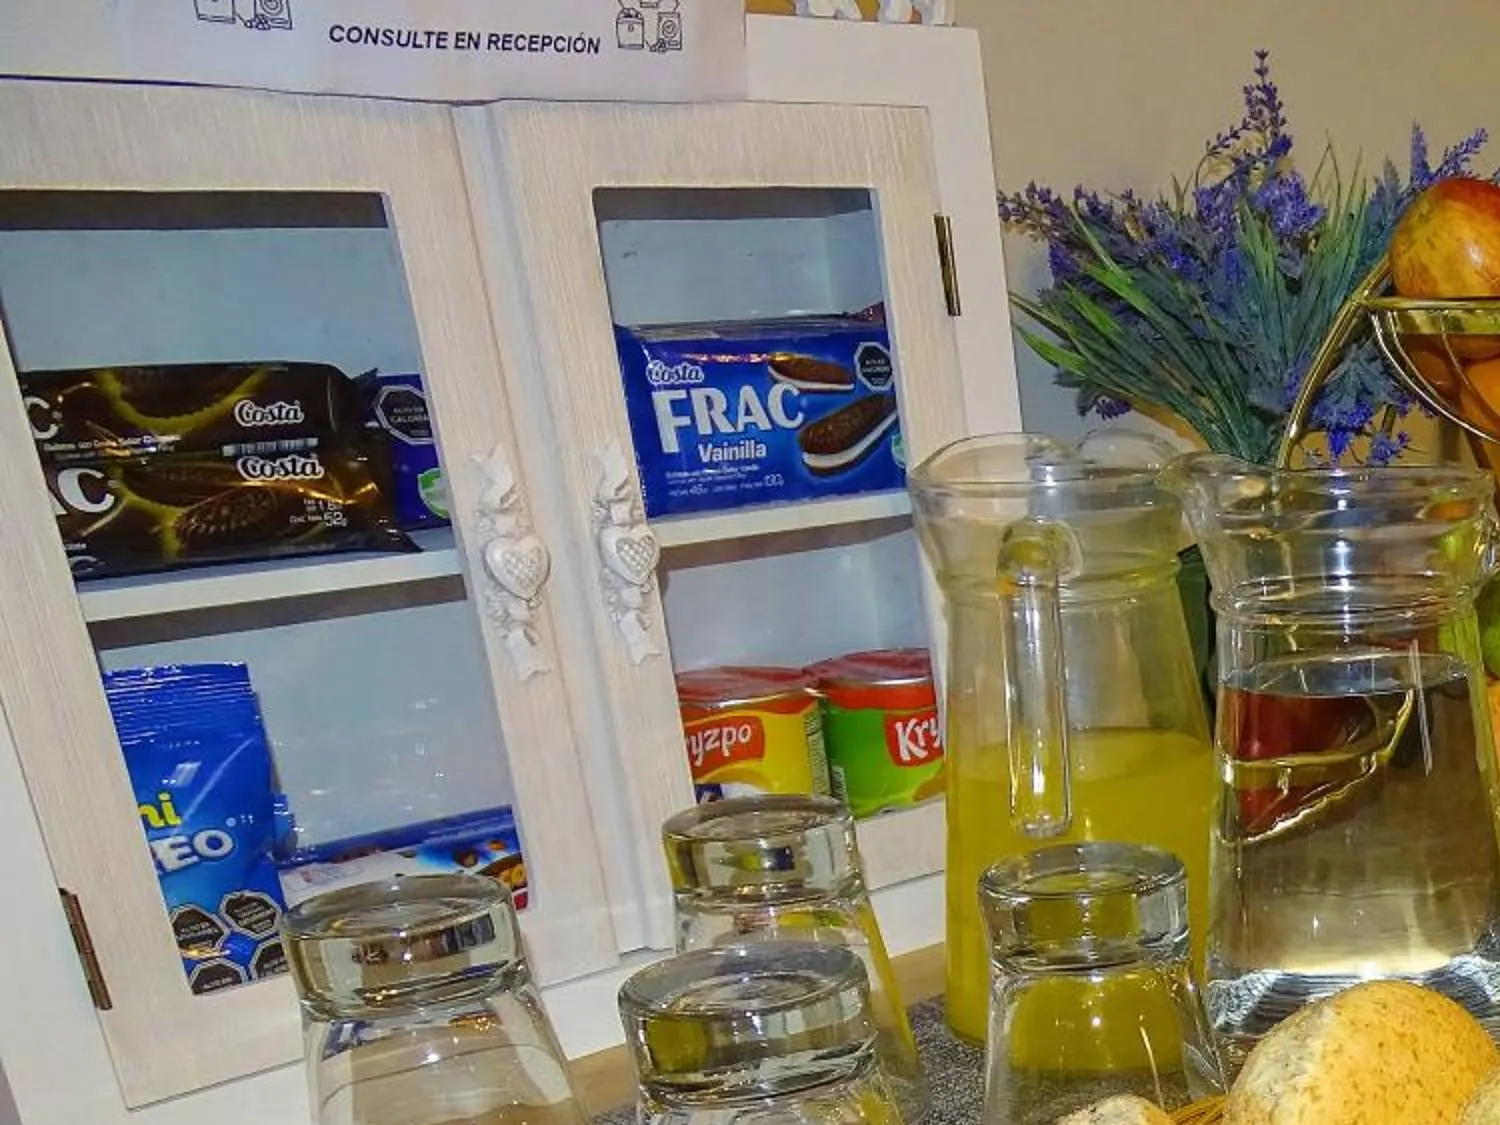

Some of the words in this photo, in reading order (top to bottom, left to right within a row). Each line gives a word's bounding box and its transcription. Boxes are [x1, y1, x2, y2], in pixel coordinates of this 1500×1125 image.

[329, 24, 448, 50] CONSULTE
[454, 32, 480, 50] EN
[487, 32, 600, 54] RECEPCIÓN
[646, 359, 704, 385] Costa
[235, 400, 304, 427] Costa
[653, 383, 804, 453] FRAC
[698, 439, 767, 463] Vainilla
[238, 455, 325, 480] Costa
[686, 724, 751, 767] yzpo
